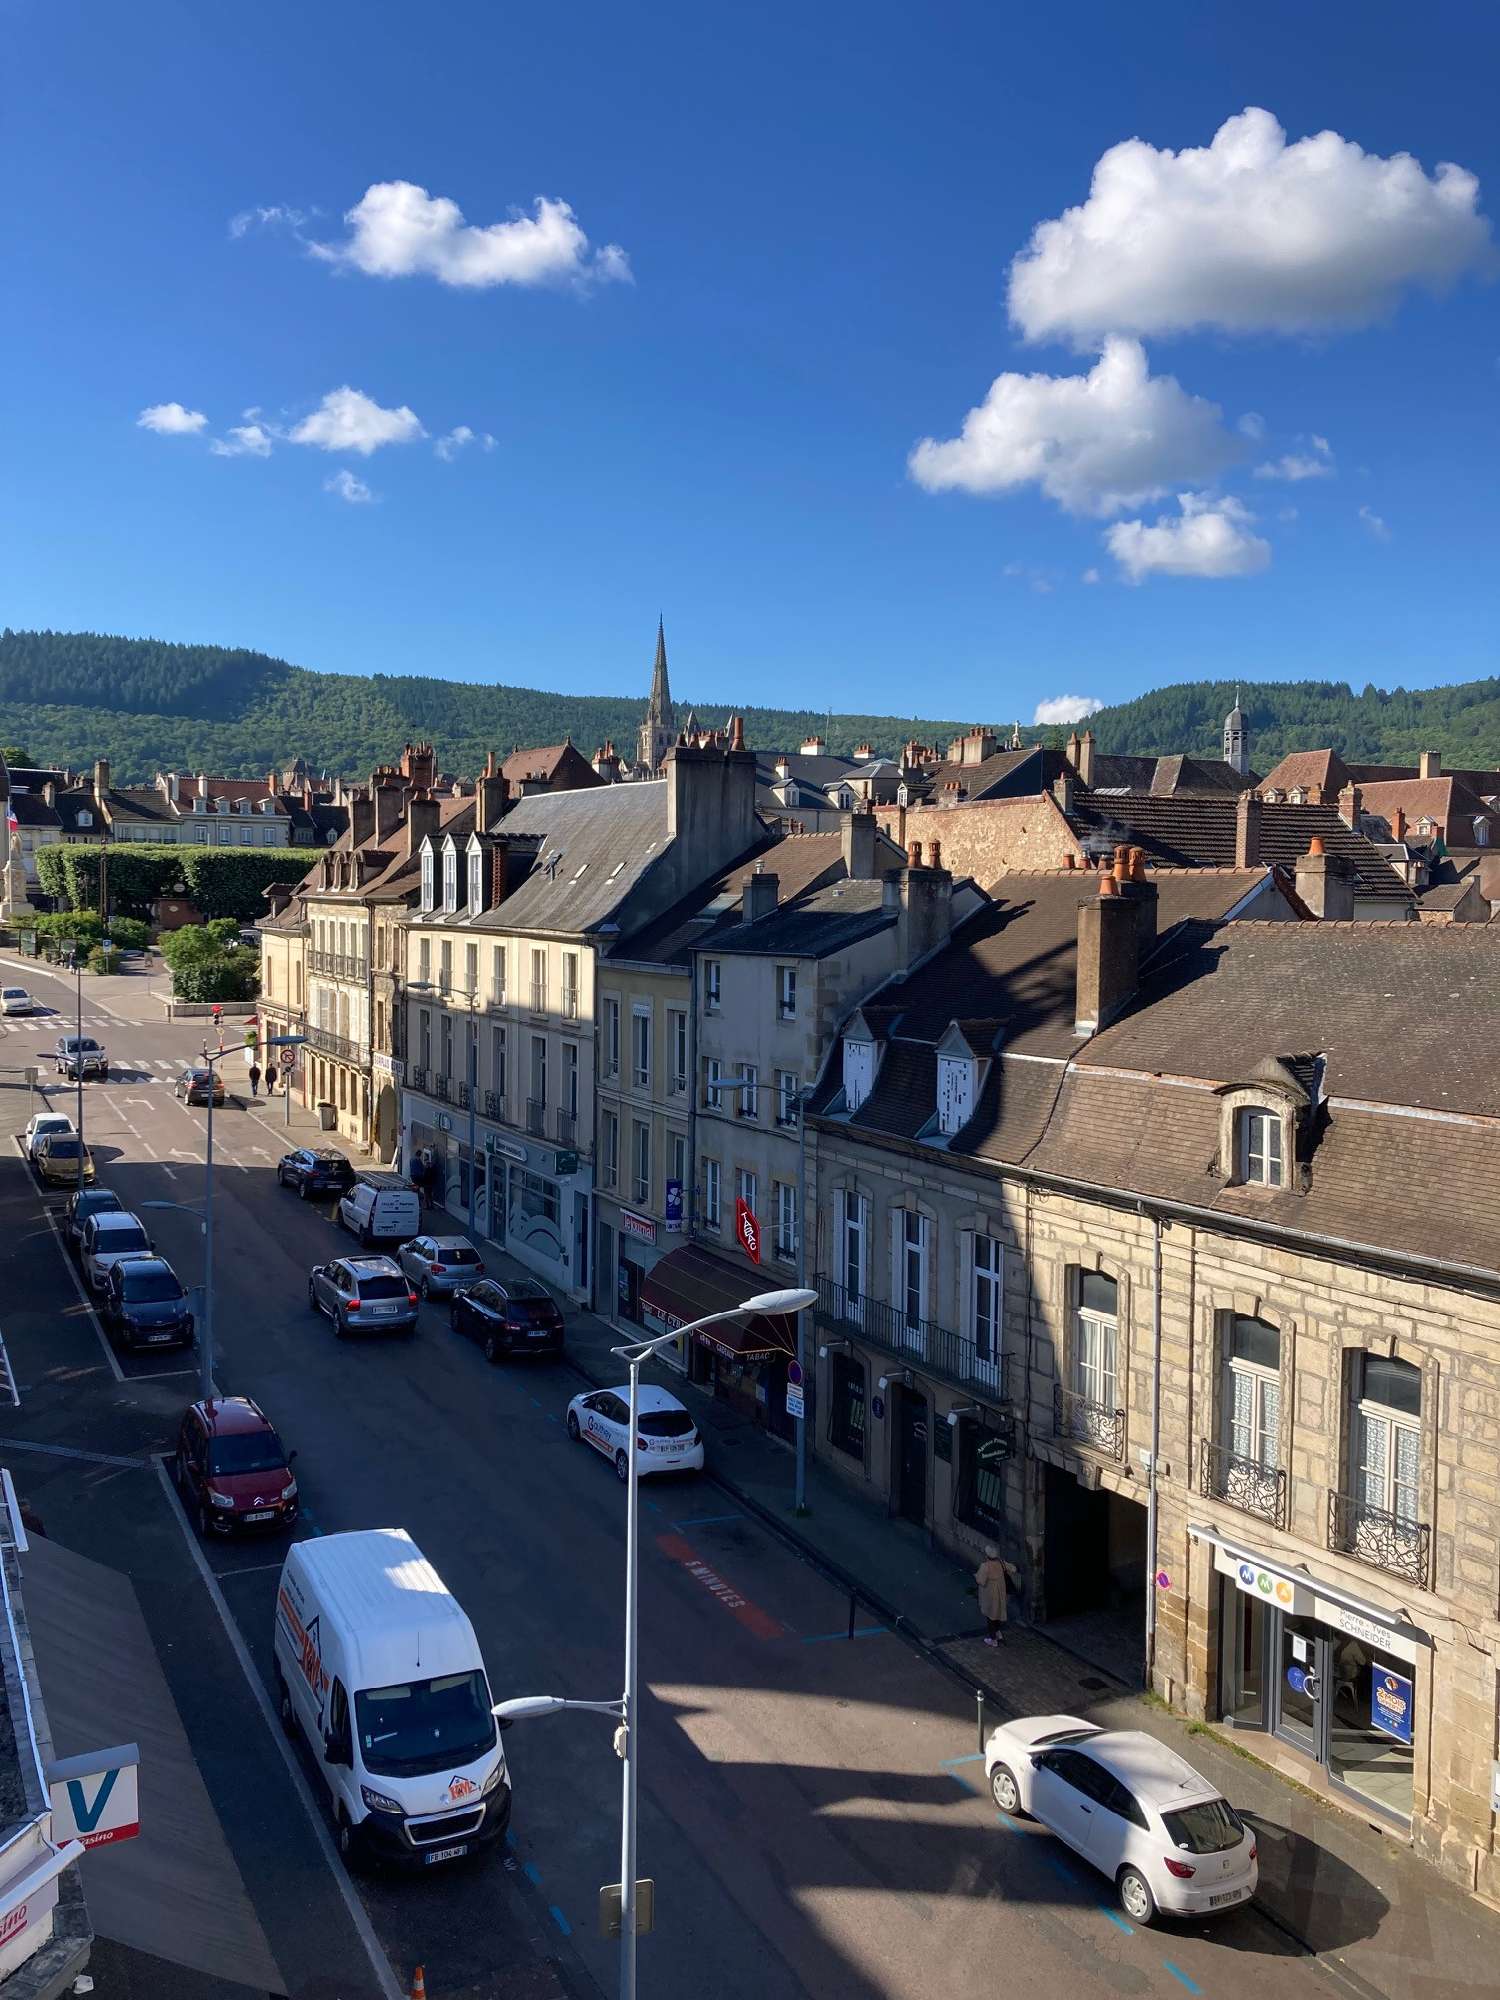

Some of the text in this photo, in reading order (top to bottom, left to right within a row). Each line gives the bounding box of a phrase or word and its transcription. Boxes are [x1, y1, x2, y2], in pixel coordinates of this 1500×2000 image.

[741, 1211, 757, 1251] TABAC
[746, 1352, 770, 1361] TABAC
[689, 1566, 746, 1608] MINUTES
[1240, 1566, 1291, 1602] MMA
[1339, 1617, 1392, 1649] SCHNEIDER
[66, 1768, 120, 1833] V
